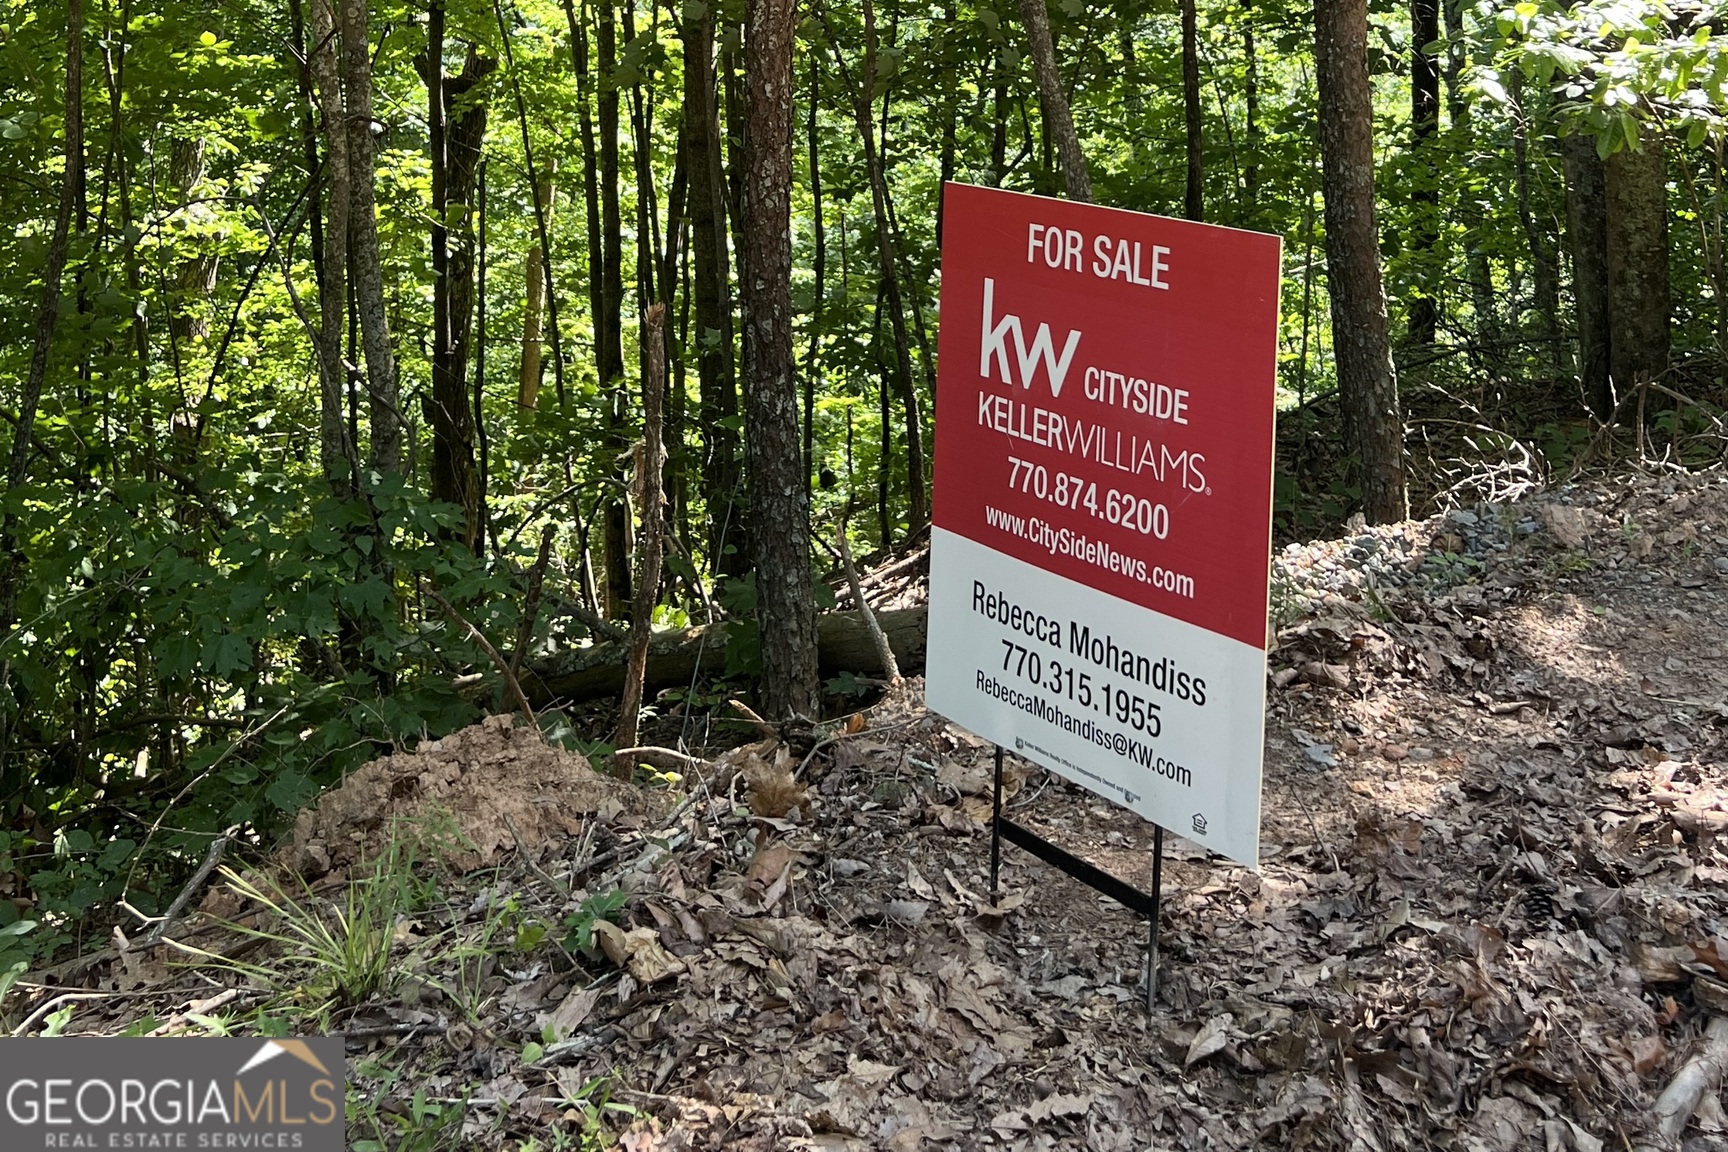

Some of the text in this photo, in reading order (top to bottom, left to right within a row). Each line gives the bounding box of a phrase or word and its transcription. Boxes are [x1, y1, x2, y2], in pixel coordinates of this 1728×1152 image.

[1027, 222, 1170, 290] FOR SALE
[1084, 366, 1189, 425] CITYSIDE
[1008, 456, 1169, 540] 770.874.6200
[985, 505, 1195, 598] www.CitySideNews.com
[972, 580, 1207, 707] Rebecca Mohandiss
[1001, 639, 1162, 738] 770.315.1955
[976, 669, 1193, 788] RebeccaMohandiss@KW.com
